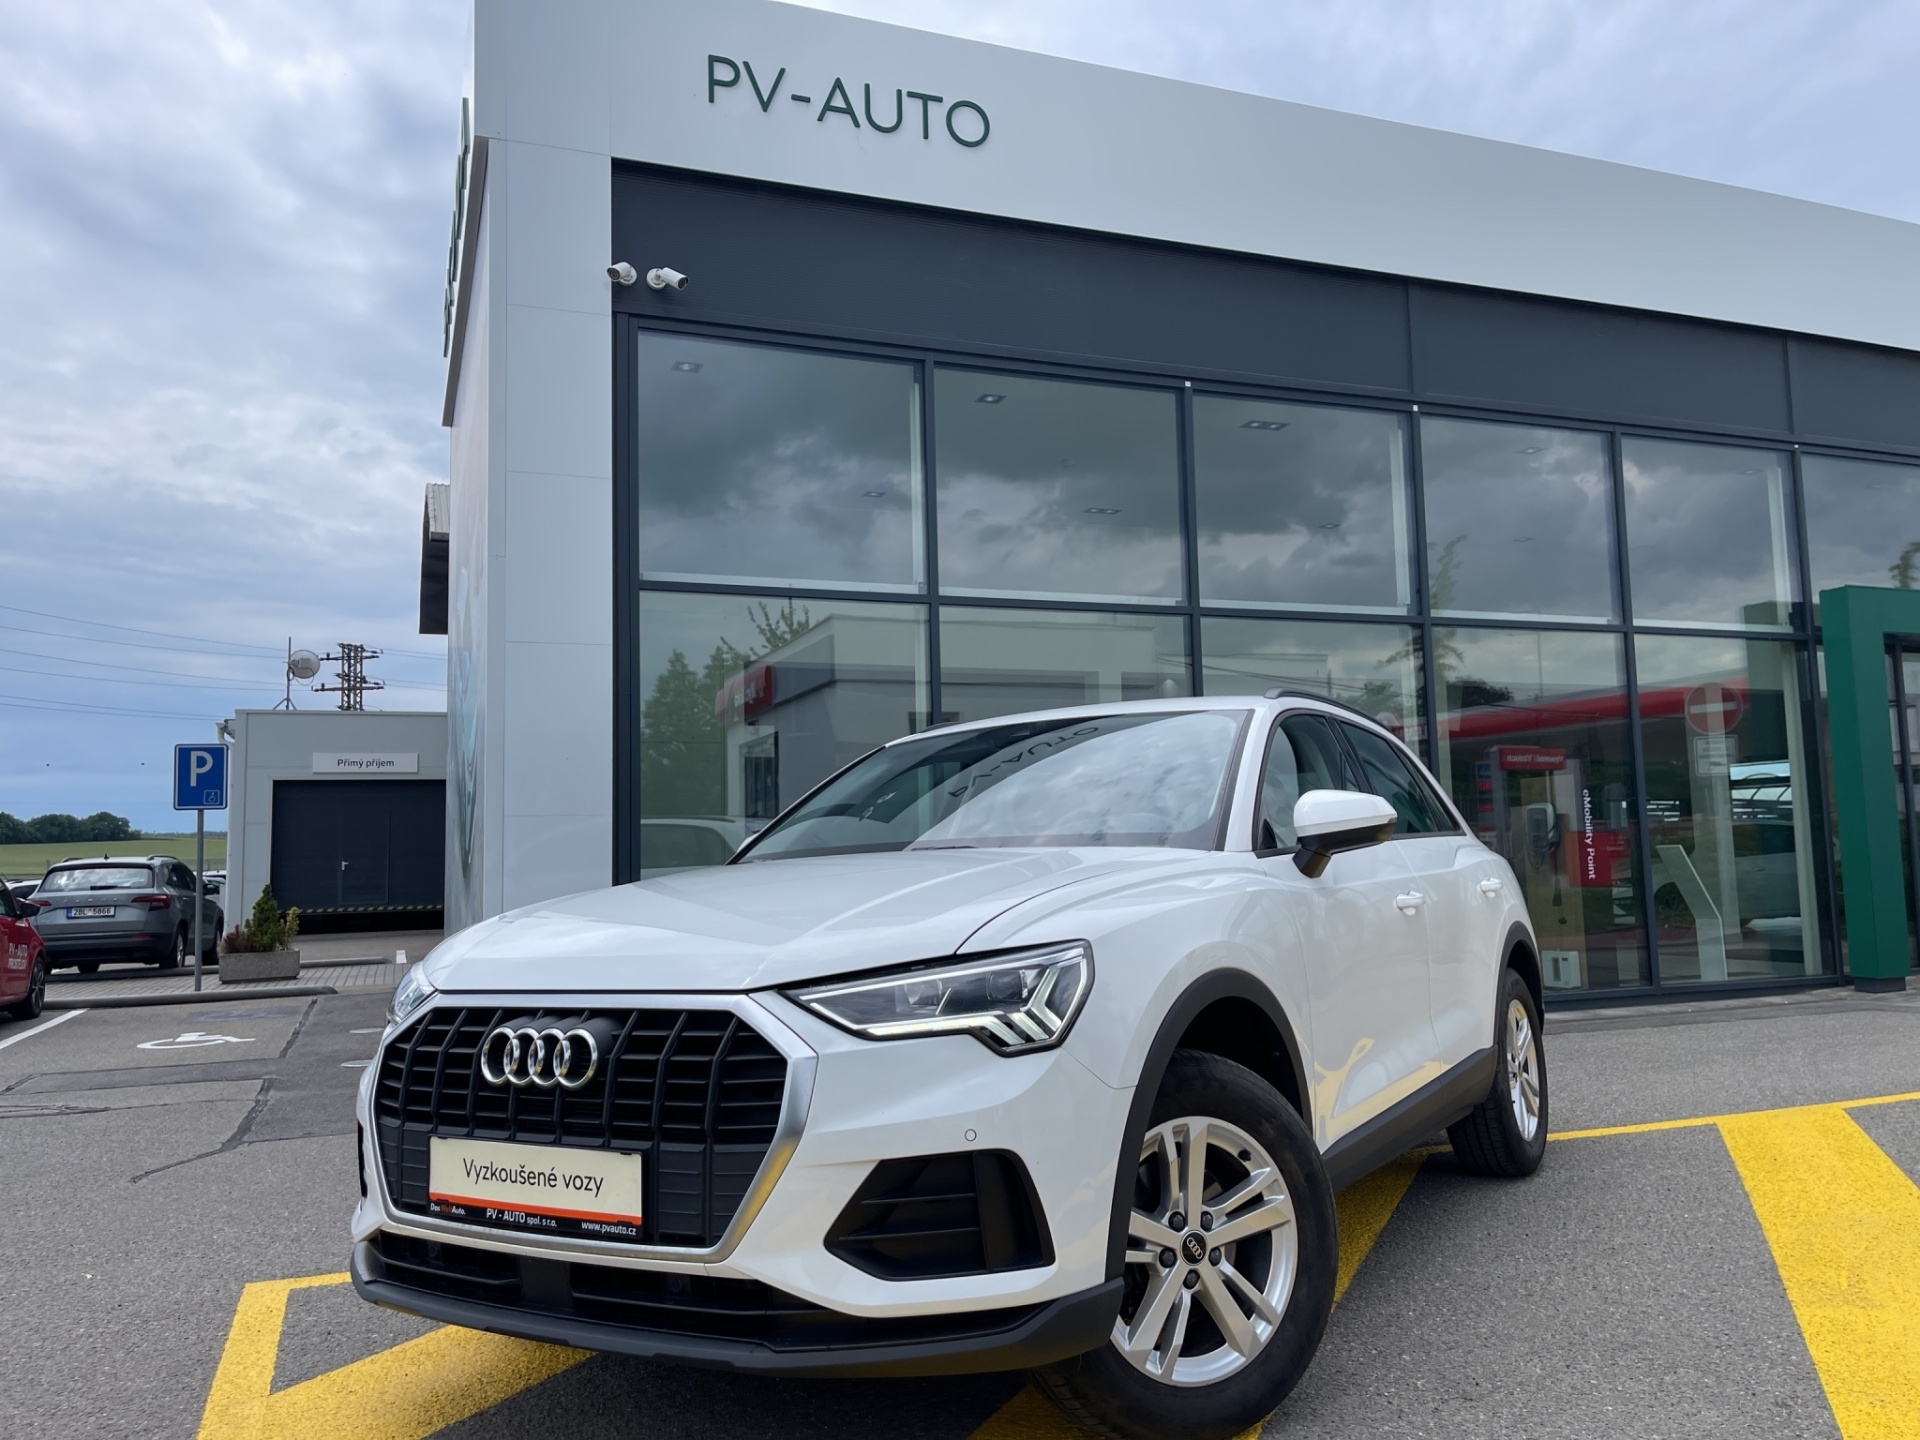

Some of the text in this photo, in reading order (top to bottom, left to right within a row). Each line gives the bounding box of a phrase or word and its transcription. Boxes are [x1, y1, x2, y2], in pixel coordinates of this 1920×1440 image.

[708, 54, 990, 147] PV-AUTO
[190, 751, 213, 787] P
[1582, 789, 1596, 880] eMobility Point
[463, 1158, 604, 1198] Vyzkoušené vozy
[486, 1208, 498, 1219] PV
[503, 1211, 526, 1223] AUTO
[526, 1216, 541, 1226] spol.
[547, 1219, 557, 1227] r.o.
[581, 1221, 637, 1236] www.pvauto.cz
